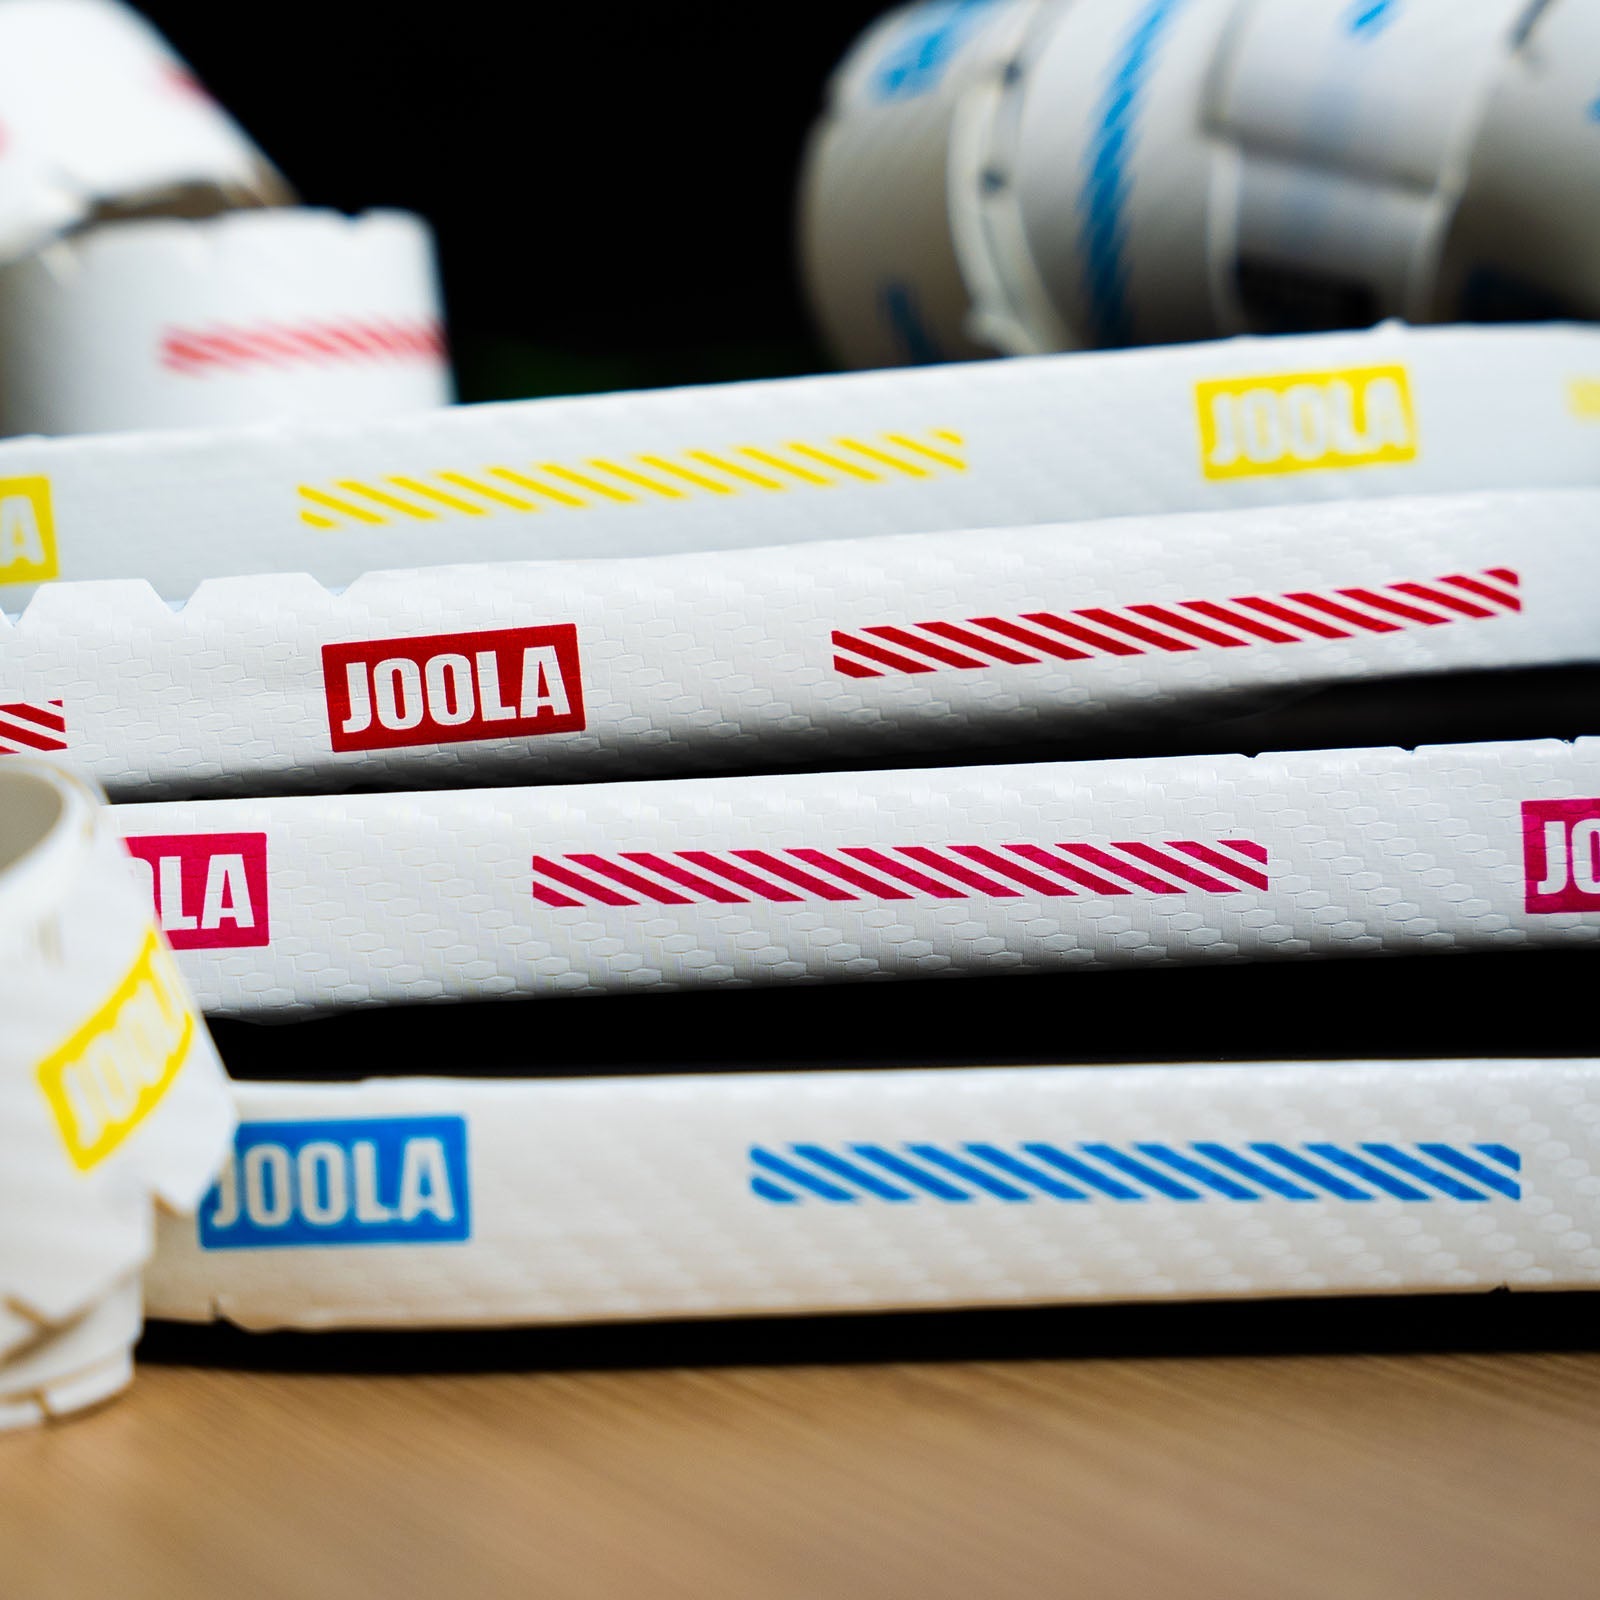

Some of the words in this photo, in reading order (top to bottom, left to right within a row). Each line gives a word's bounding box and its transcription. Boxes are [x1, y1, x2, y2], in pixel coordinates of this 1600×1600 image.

[1210, 375, 1407, 466] JOOLA
[342, 645, 571, 734] JOOLA
[211, 1137, 455, 1228] JOOLA
